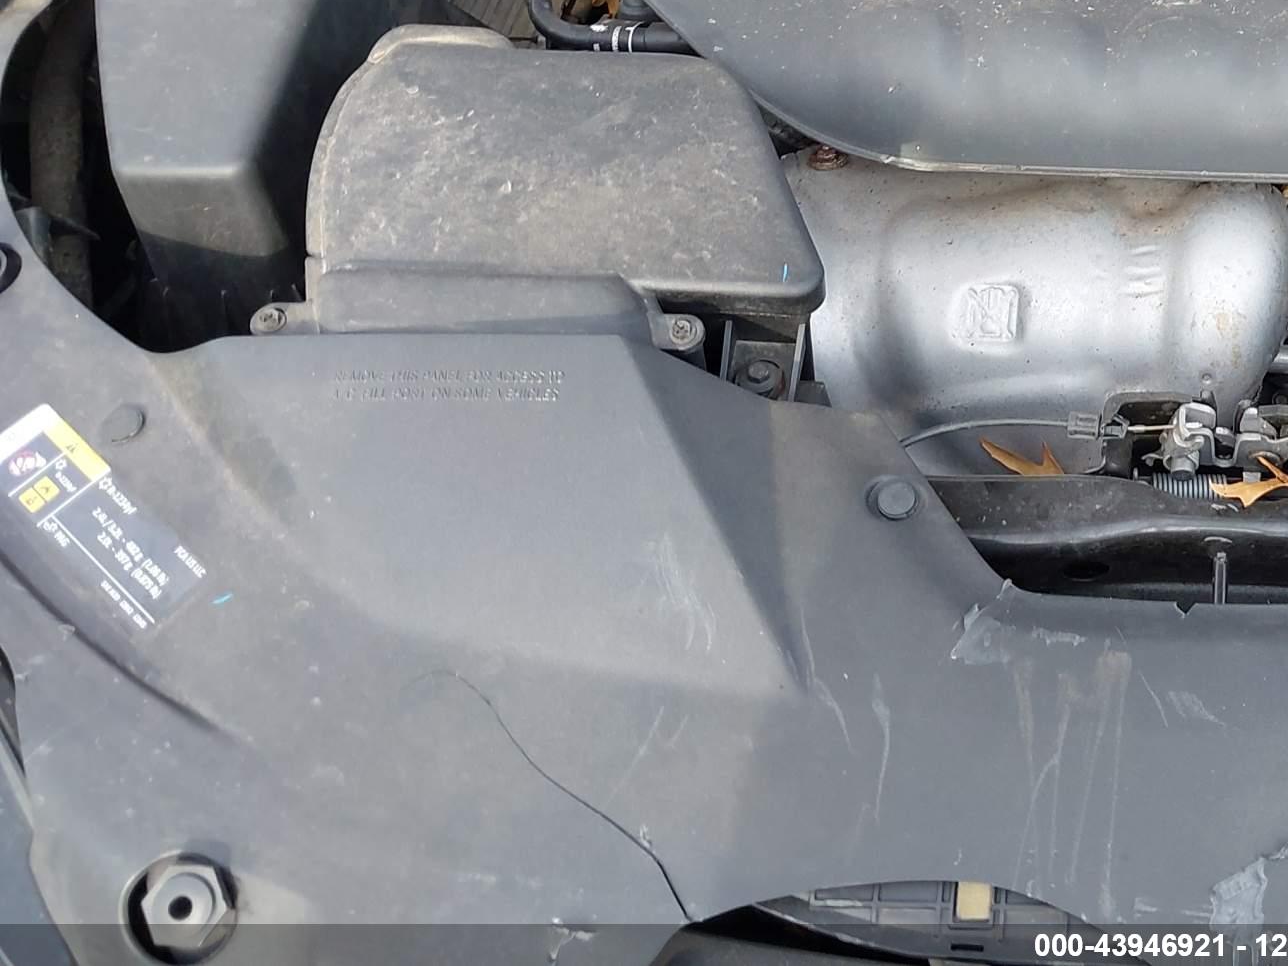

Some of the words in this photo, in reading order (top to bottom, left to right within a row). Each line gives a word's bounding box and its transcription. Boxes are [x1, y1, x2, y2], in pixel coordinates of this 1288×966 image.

[334, 369, 384, 383] REMOVE
[390, 369, 419, 382] THIS
[423, 369, 462, 382] PANEL
[466, 369, 492, 382] FOR
[496, 369, 545, 383] ACCESS
[431, 387, 449, 401] ON
[454, 387, 491, 401] SOME
[496, 387, 560, 402] VEHICLES
